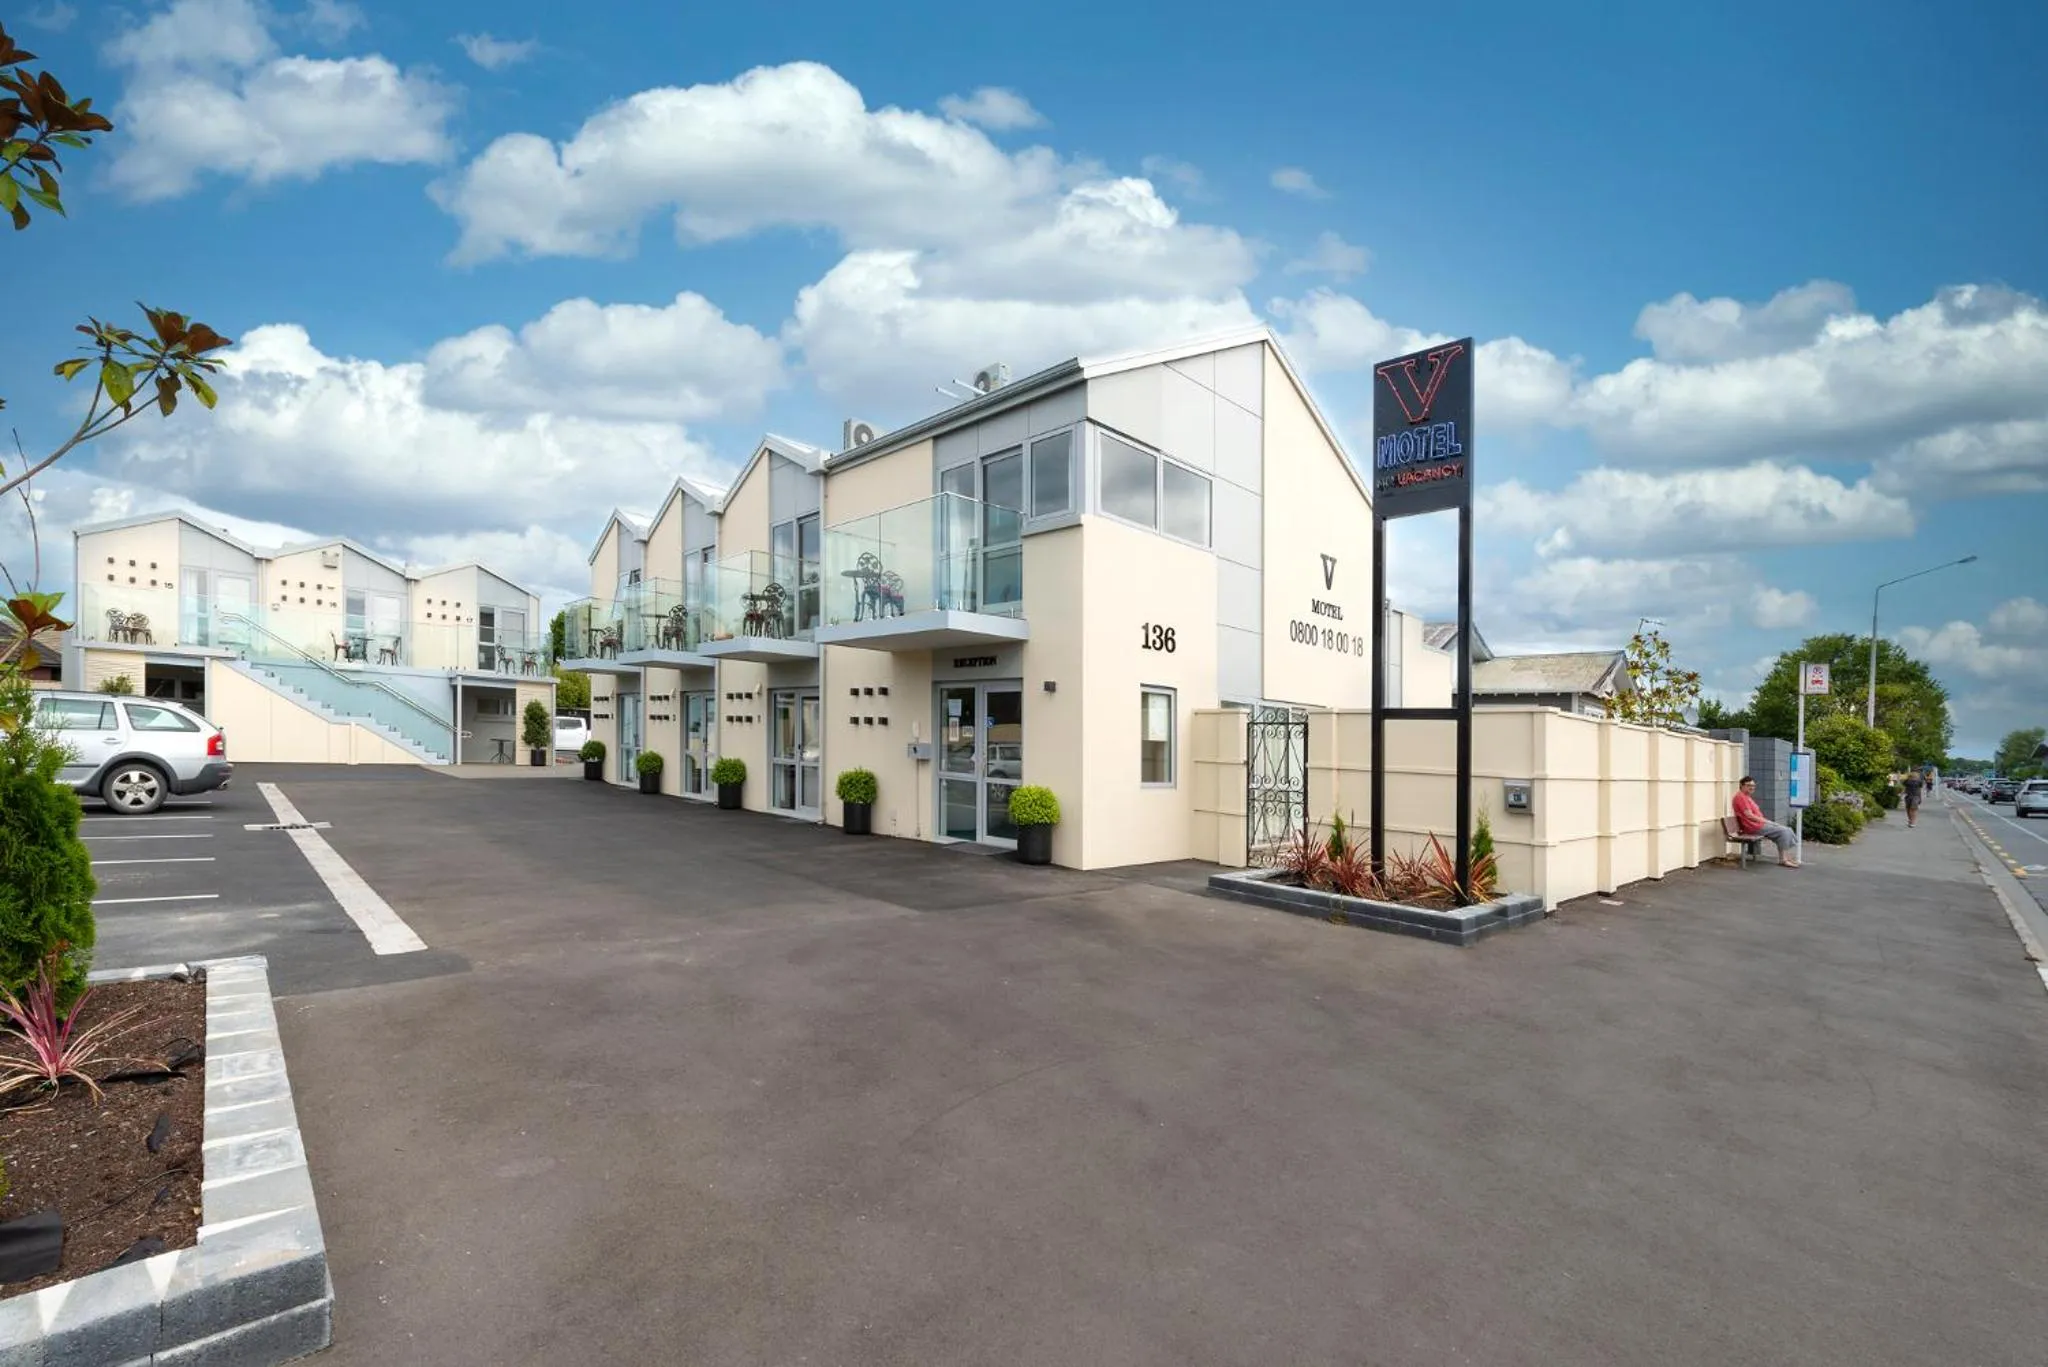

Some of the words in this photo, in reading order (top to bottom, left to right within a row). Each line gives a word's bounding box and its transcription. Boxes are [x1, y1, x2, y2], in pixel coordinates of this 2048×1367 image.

[1377, 345, 1464, 422] V
[1377, 422, 1463, 468] MOTEL
[1320, 552, 1337, 590] V
[1312, 598, 1344, 621] MOTEL
[1141, 622, 1177, 653] 136
[1290, 619, 1318, 646] 0800
[1321, 628, 1334, 650] 18
[1336, 631, 1349, 654] 00
[1352, 636, 1364, 657] 18
